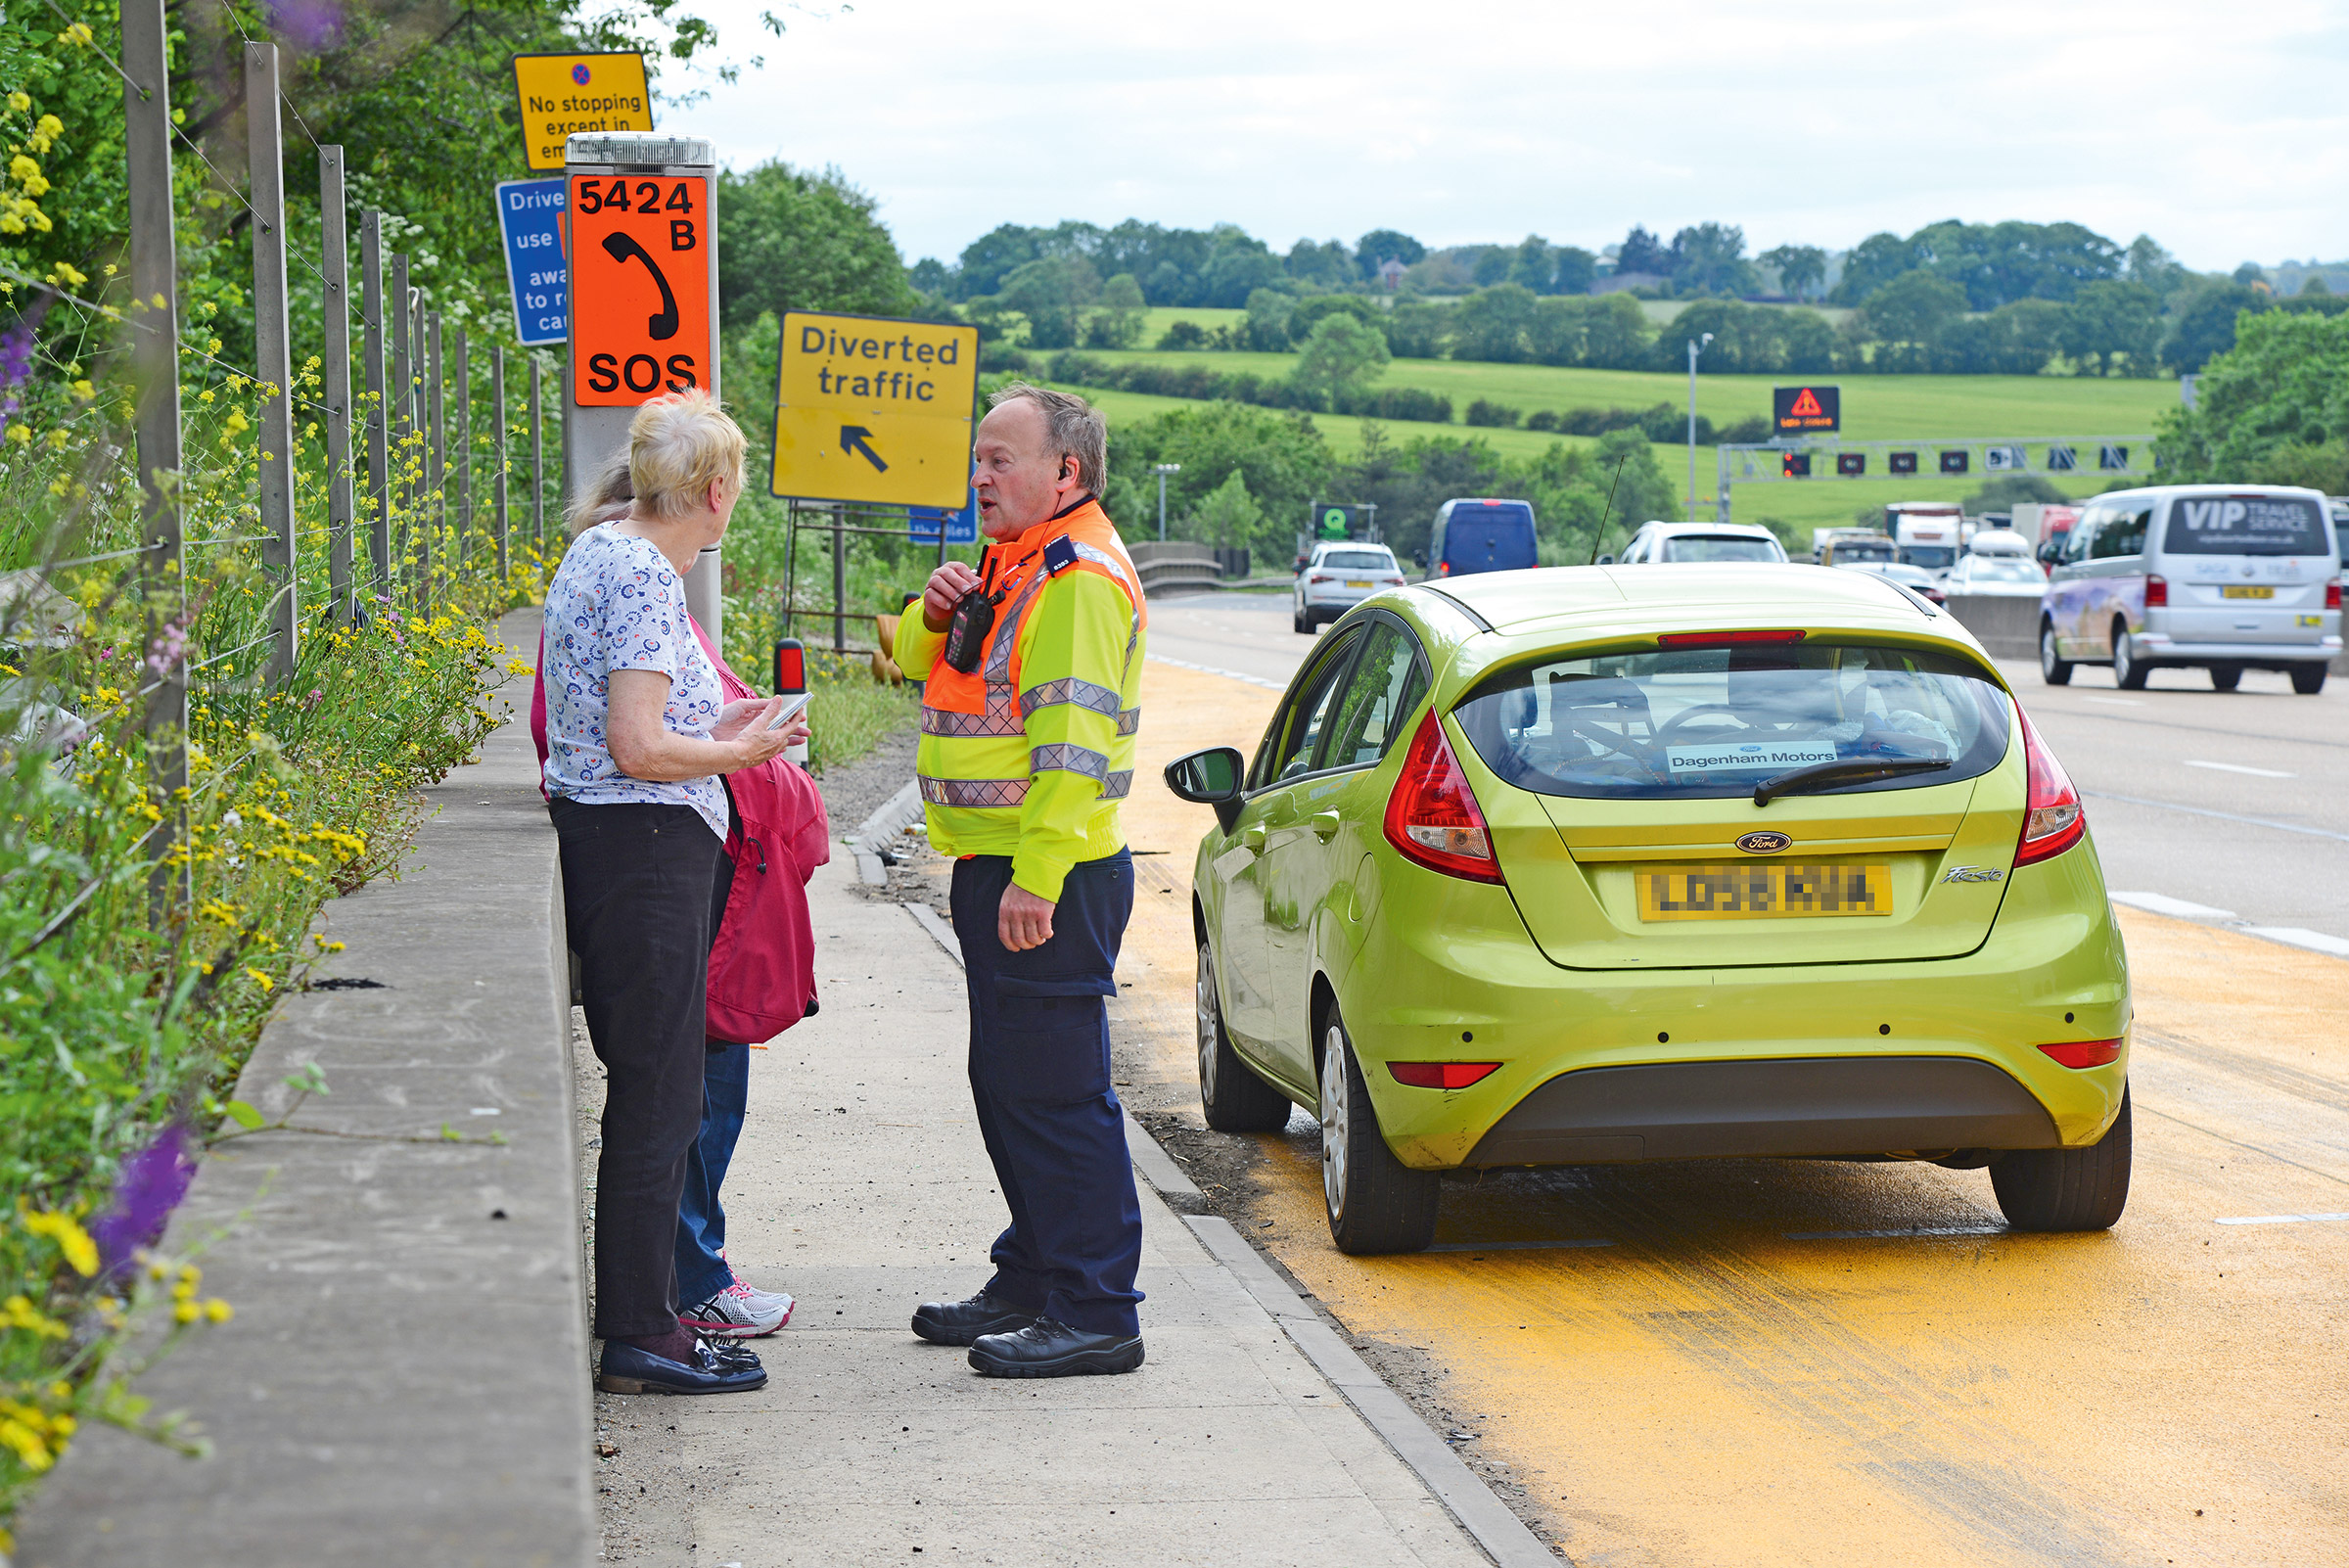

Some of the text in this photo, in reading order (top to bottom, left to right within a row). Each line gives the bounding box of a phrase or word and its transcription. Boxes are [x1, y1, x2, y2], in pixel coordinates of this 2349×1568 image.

[529, 93, 641, 114] No stopping
[546, 116, 630, 135] except in
[509, 190, 565, 210] Drive
[578, 180, 694, 214] 5424
[516, 232, 553, 250] use
[669, 219, 696, 252] B
[525, 292, 548, 309] to
[801, 326, 958, 365] Diverted
[588, 353, 697, 393] SOS
[818, 366, 935, 401] traffic
[2184, 500, 2246, 530] VIP
[1672, 752, 1835, 768] Dagenham Motors
[1748, 836, 1779, 849] Ford
[1939, 865, 2005, 884] Fiesta
